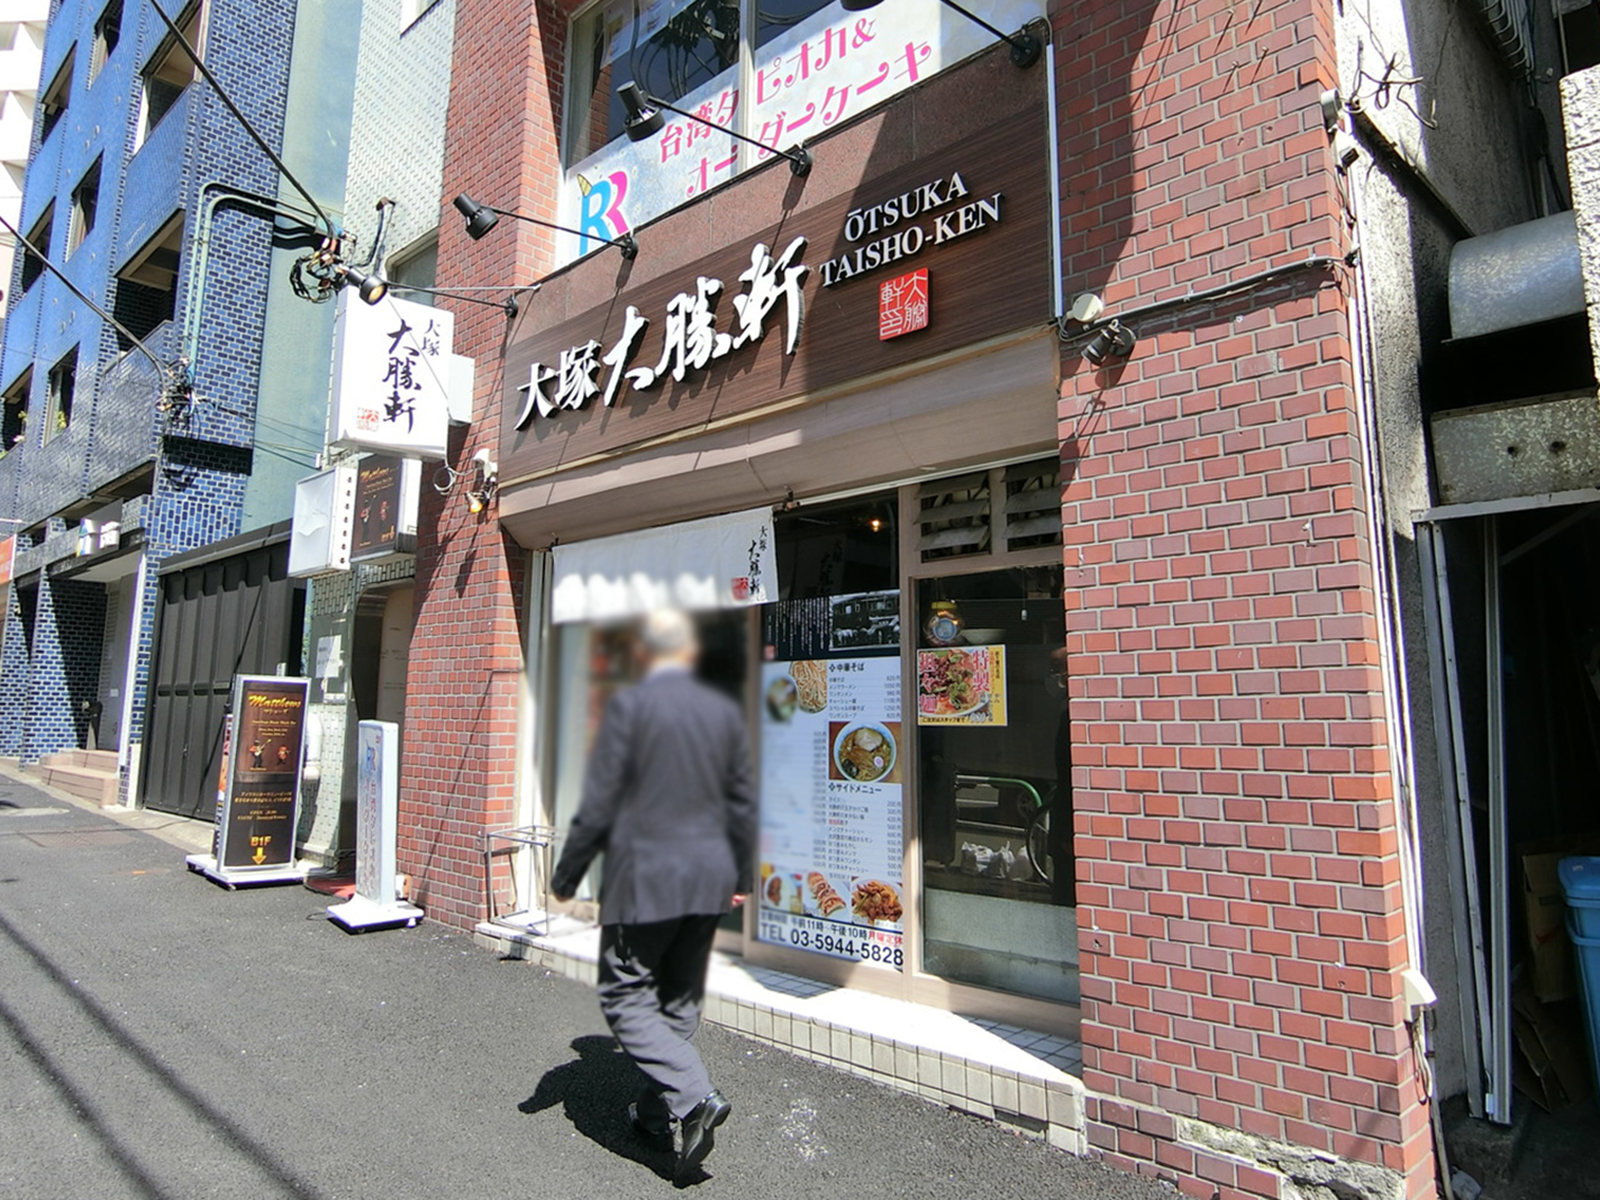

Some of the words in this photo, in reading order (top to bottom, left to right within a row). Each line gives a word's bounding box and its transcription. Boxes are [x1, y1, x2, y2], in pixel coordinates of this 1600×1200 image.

[819, 193, 1003, 288] TAISHO-KEN
[422, 318, 441, 357] 大塚
[382, 318, 422, 434] 大勝軒
[835, 783, 882, 794] サイドメニュー
[250, 836, 272, 847] B1F
[791, 928, 903, 966] 03-5944-5828
